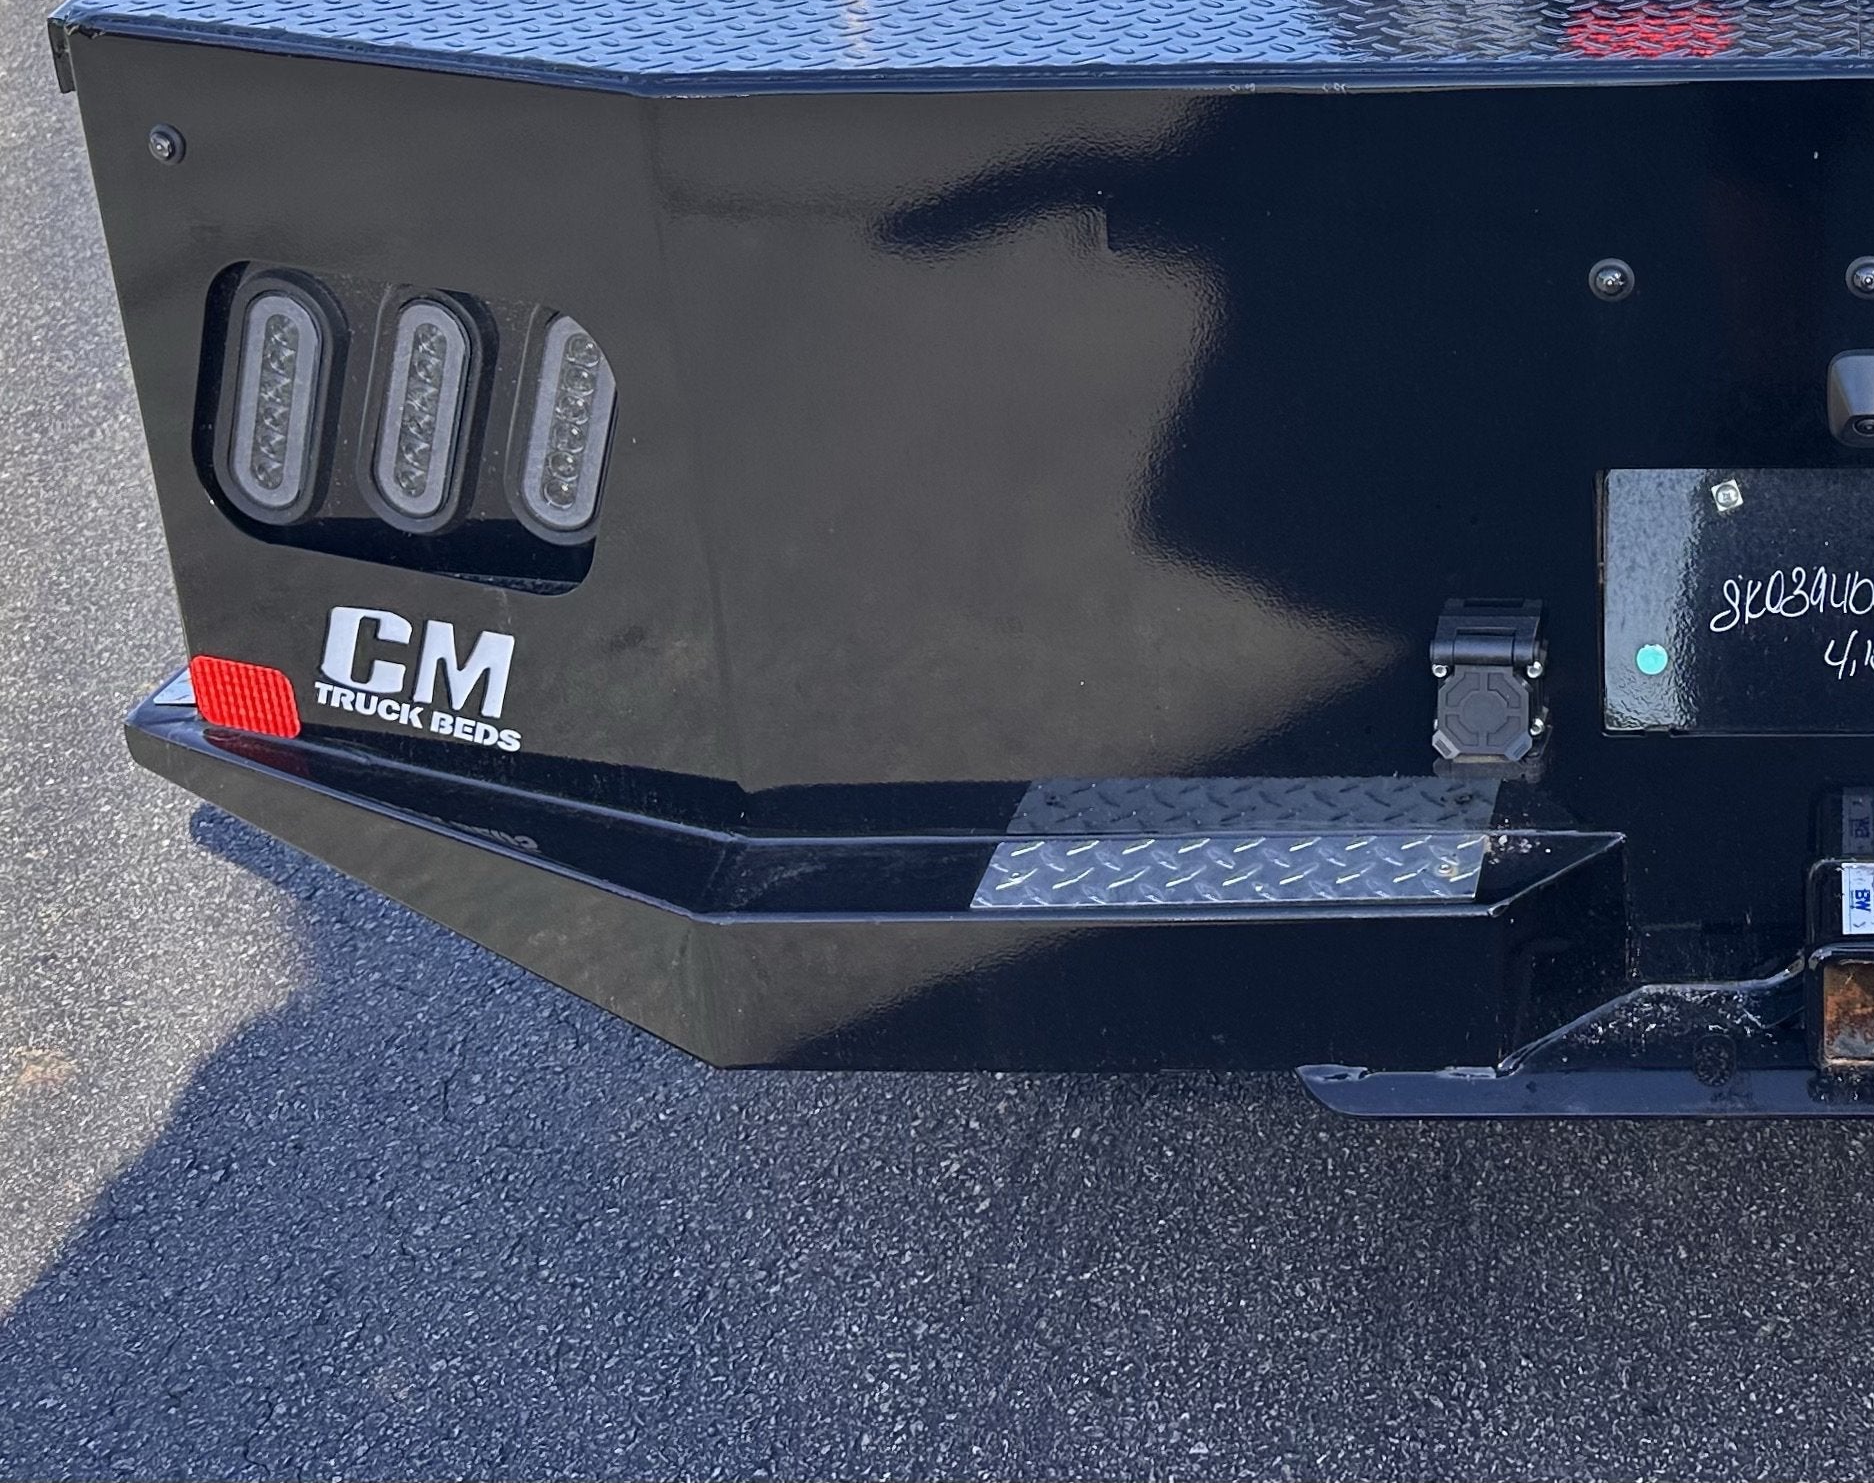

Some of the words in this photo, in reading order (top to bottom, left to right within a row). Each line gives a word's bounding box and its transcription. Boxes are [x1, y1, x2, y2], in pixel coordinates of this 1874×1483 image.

[320, 606, 516, 719] CM
[314, 681, 425, 729] TRUCK
[430, 710, 522, 752] BEDS
